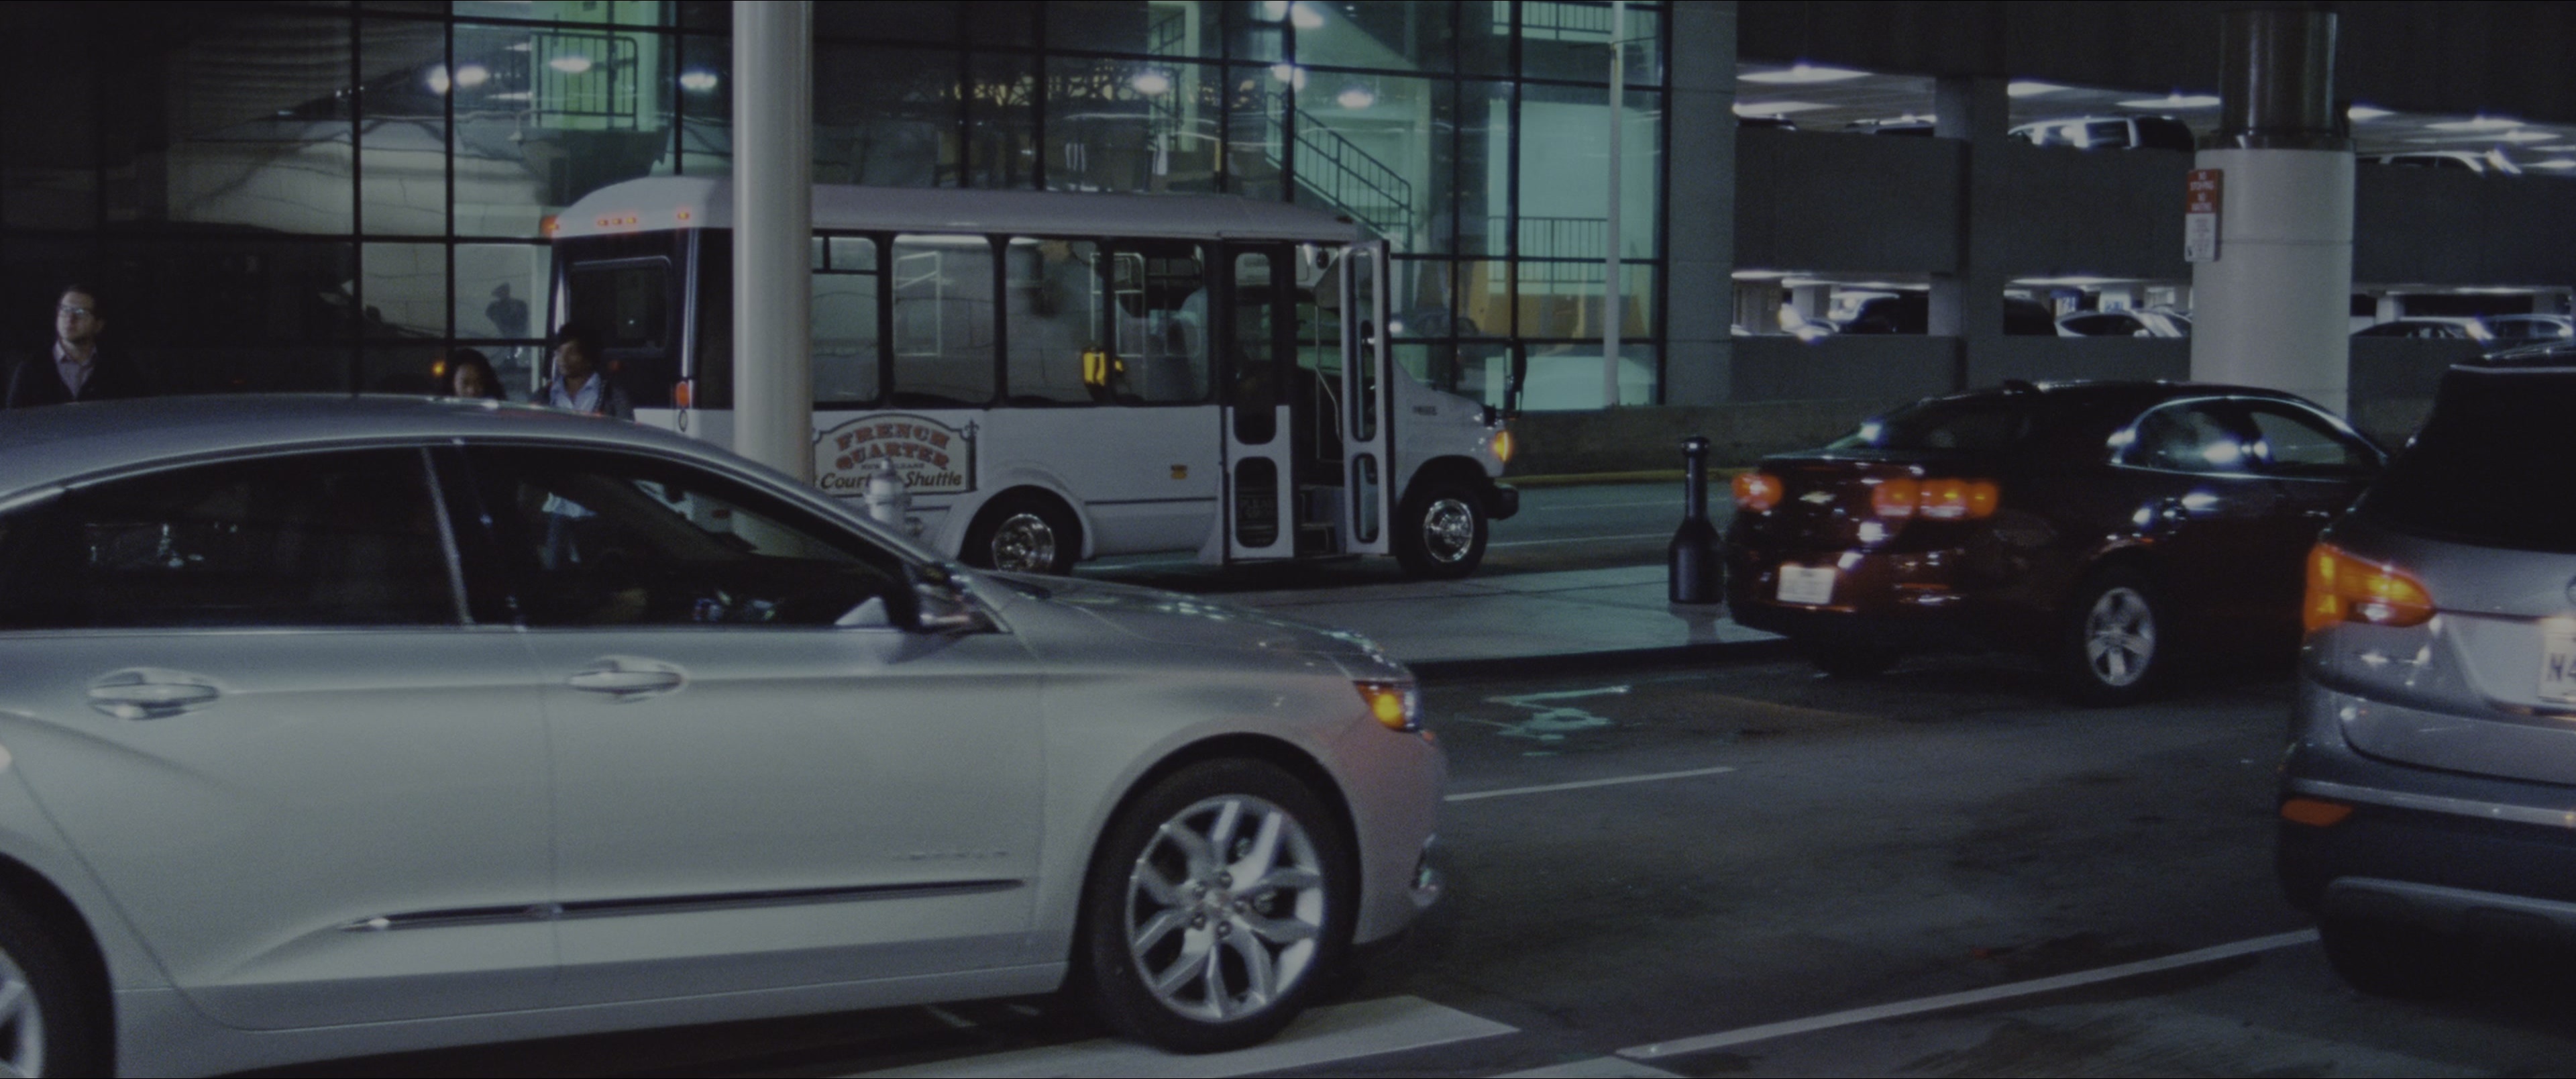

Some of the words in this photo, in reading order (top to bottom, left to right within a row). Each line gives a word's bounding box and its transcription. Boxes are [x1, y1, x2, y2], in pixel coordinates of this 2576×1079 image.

[835, 423, 950, 450] FRENCH
[835, 442, 949, 470] QUARTER
[904, 470, 963, 489] Shuttle
